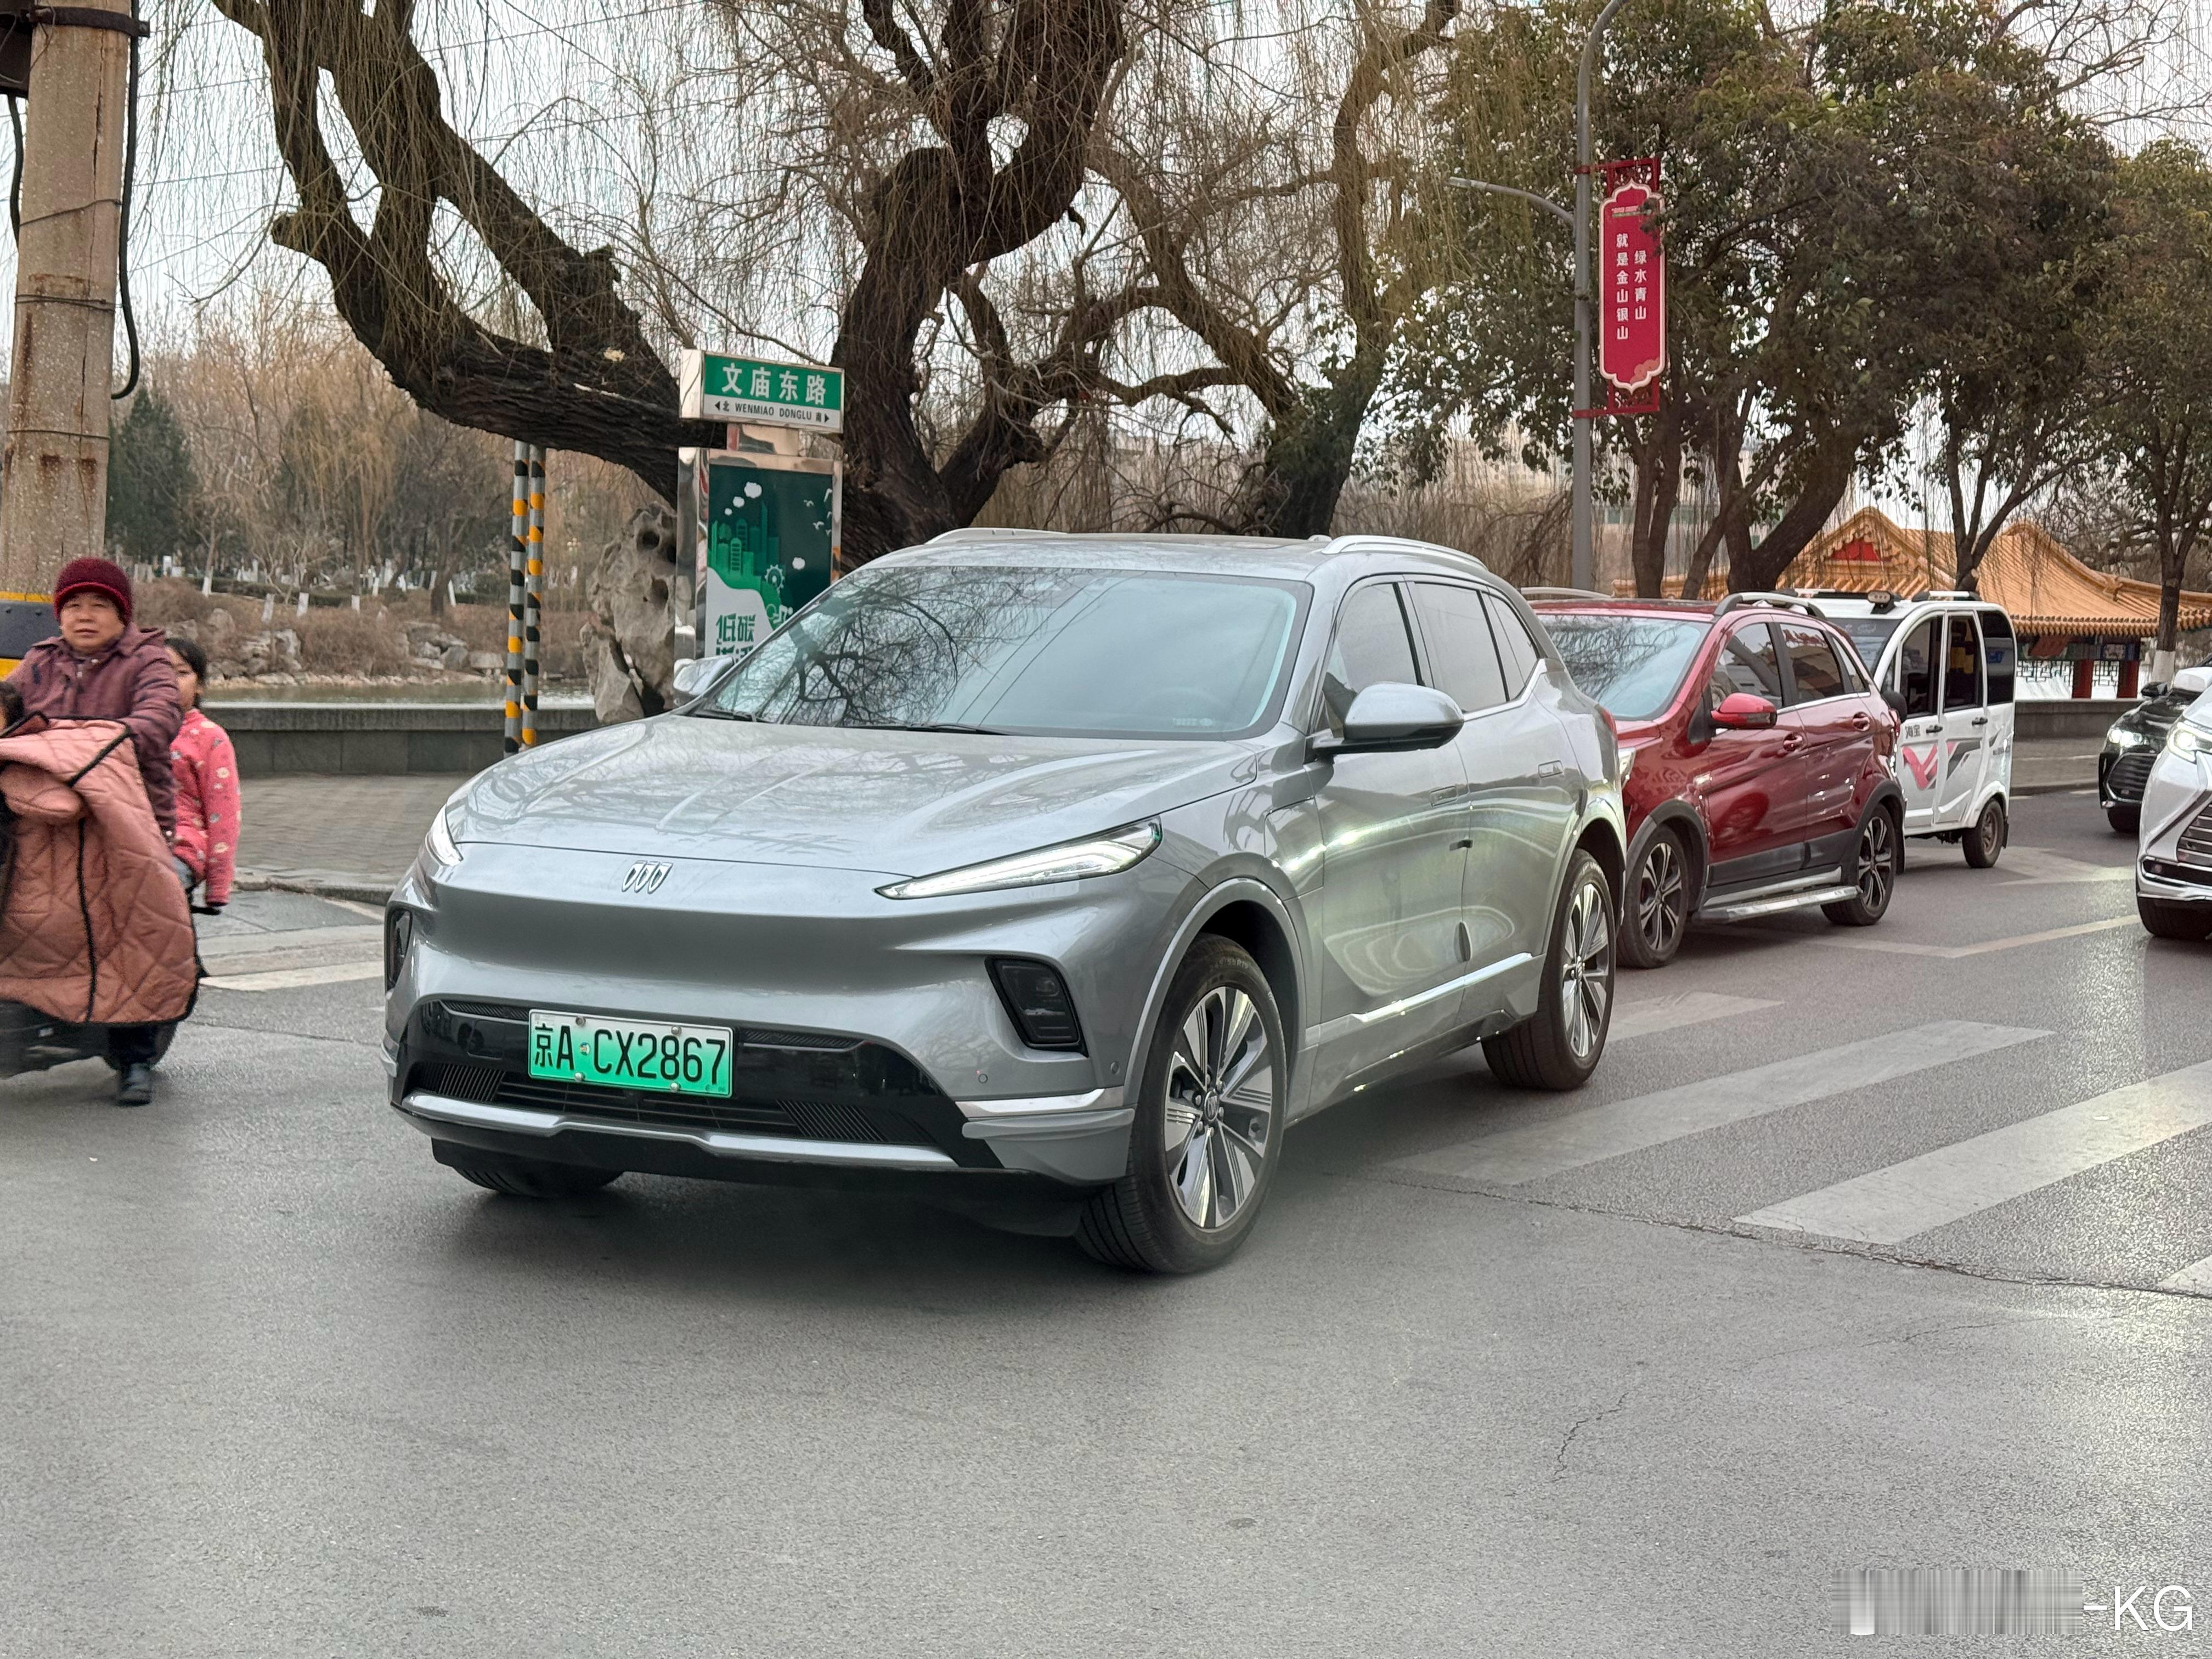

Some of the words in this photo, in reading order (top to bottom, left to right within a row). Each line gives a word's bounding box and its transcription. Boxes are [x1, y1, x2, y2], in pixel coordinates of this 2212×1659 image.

[1616, 233, 1629, 340] 就是金山银山
[1634, 250, 1647, 320] 绿水青山
[721, 363, 826, 405] 文庙东路
[723, 400, 730, 412] 北
[735, 403, 774, 416] WENMIAO
[779, 408, 812, 420] DONGLU
[715, 613, 756, 641] 低碳
